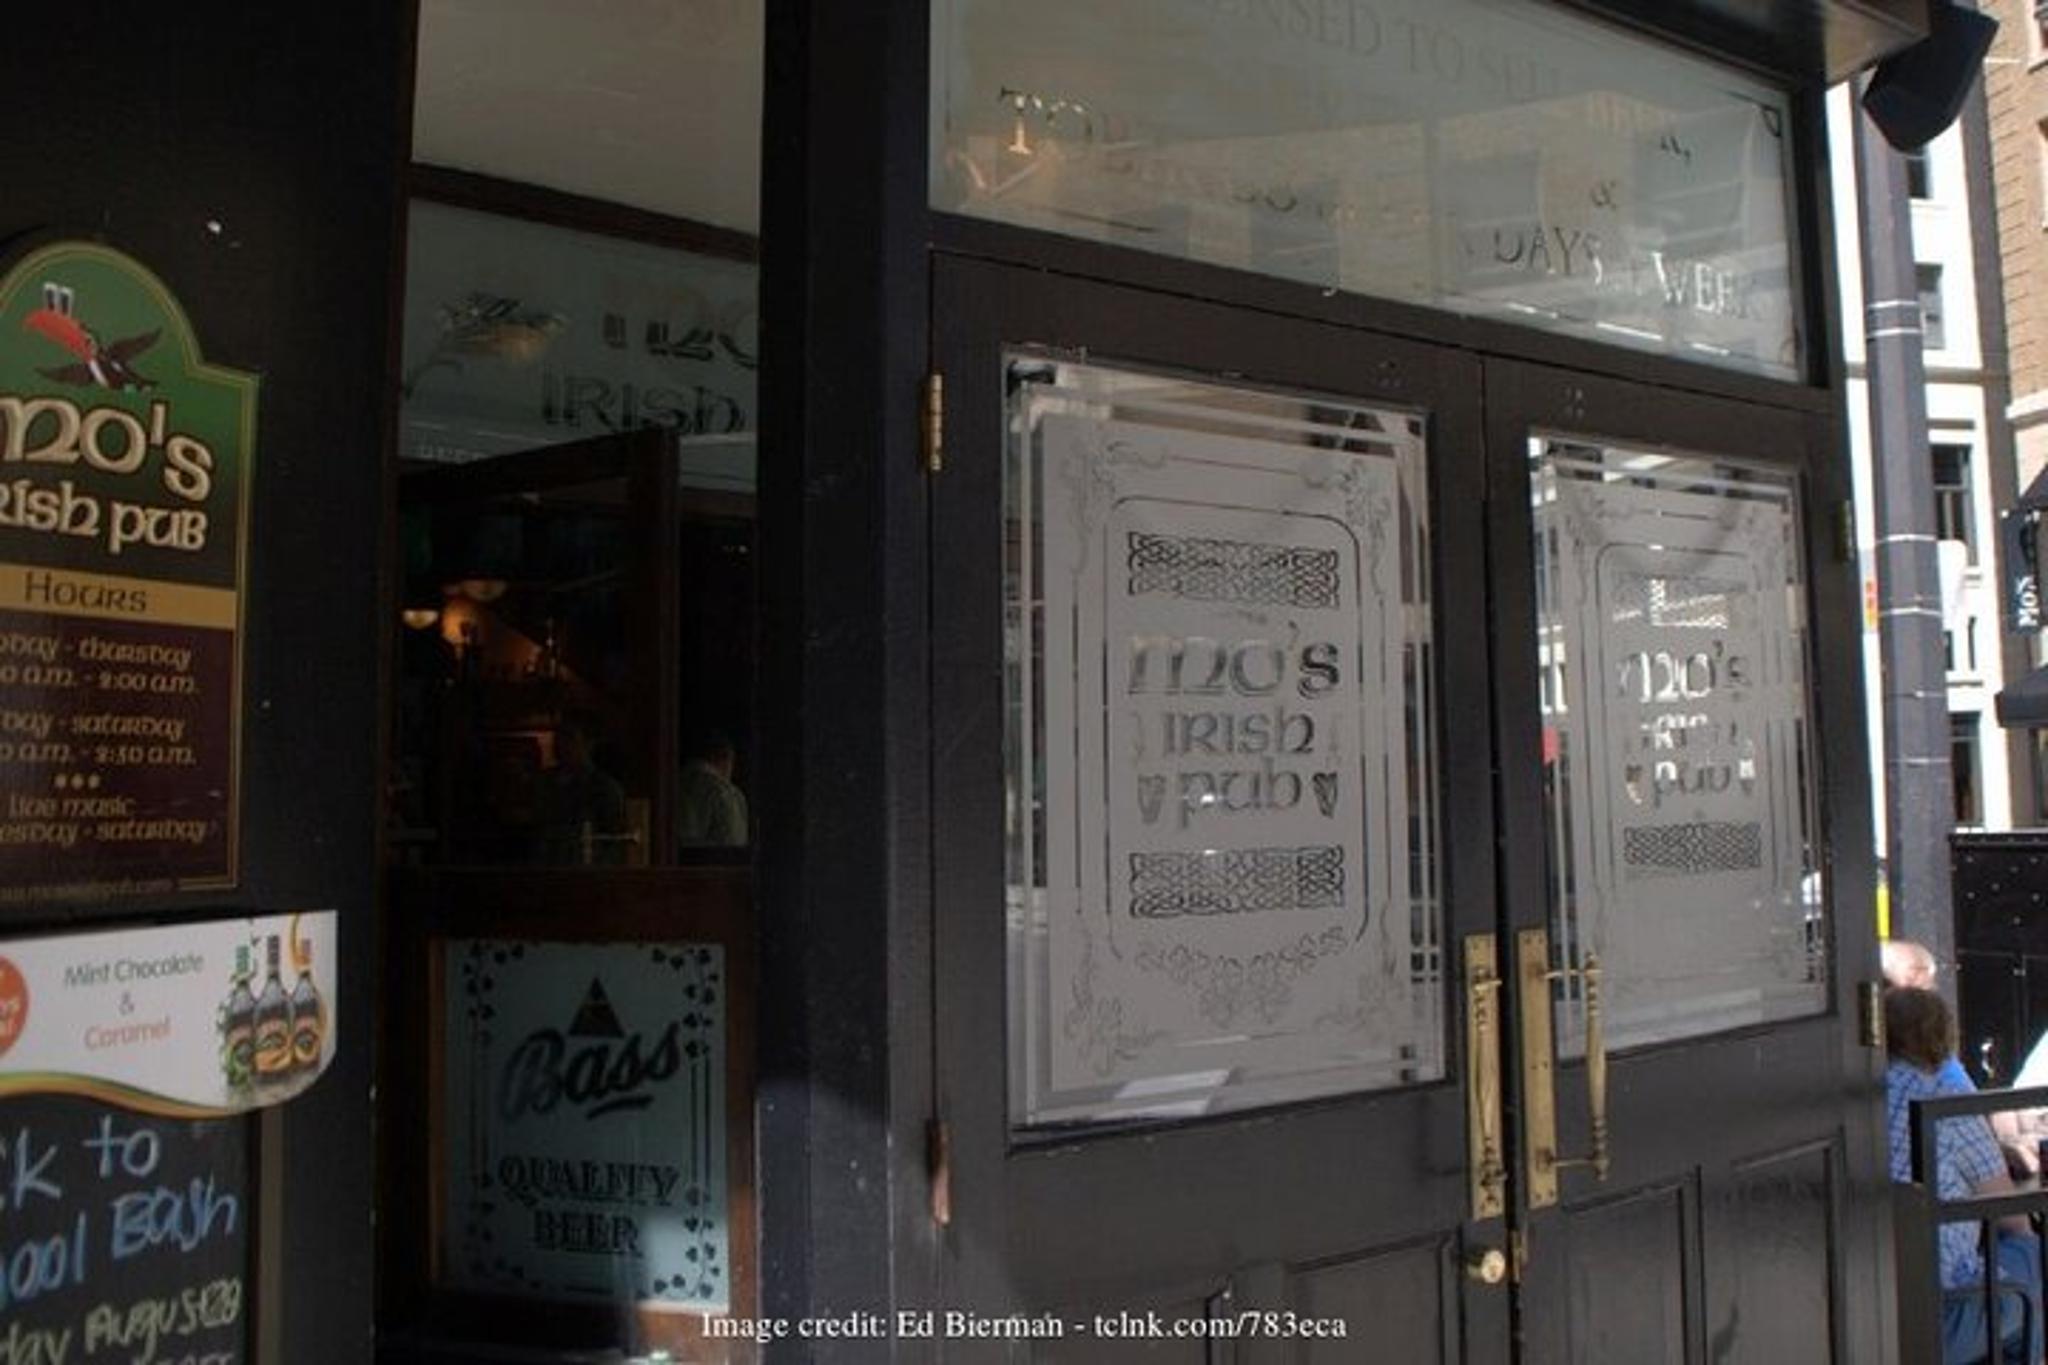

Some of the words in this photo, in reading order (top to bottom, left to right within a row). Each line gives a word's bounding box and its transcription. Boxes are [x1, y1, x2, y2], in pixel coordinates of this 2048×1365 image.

[63, 962, 110, 989] Mint
[113, 951, 205, 982] Chocolate
[118, 991, 136, 1018] &
[83, 1015, 172, 1052] Caramel
[499, 1019, 682, 1123] Bass
[83, 1113, 159, 1178] to
[497, 1154, 681, 1208] QUALITY
[532, 1208, 643, 1258] BEER
